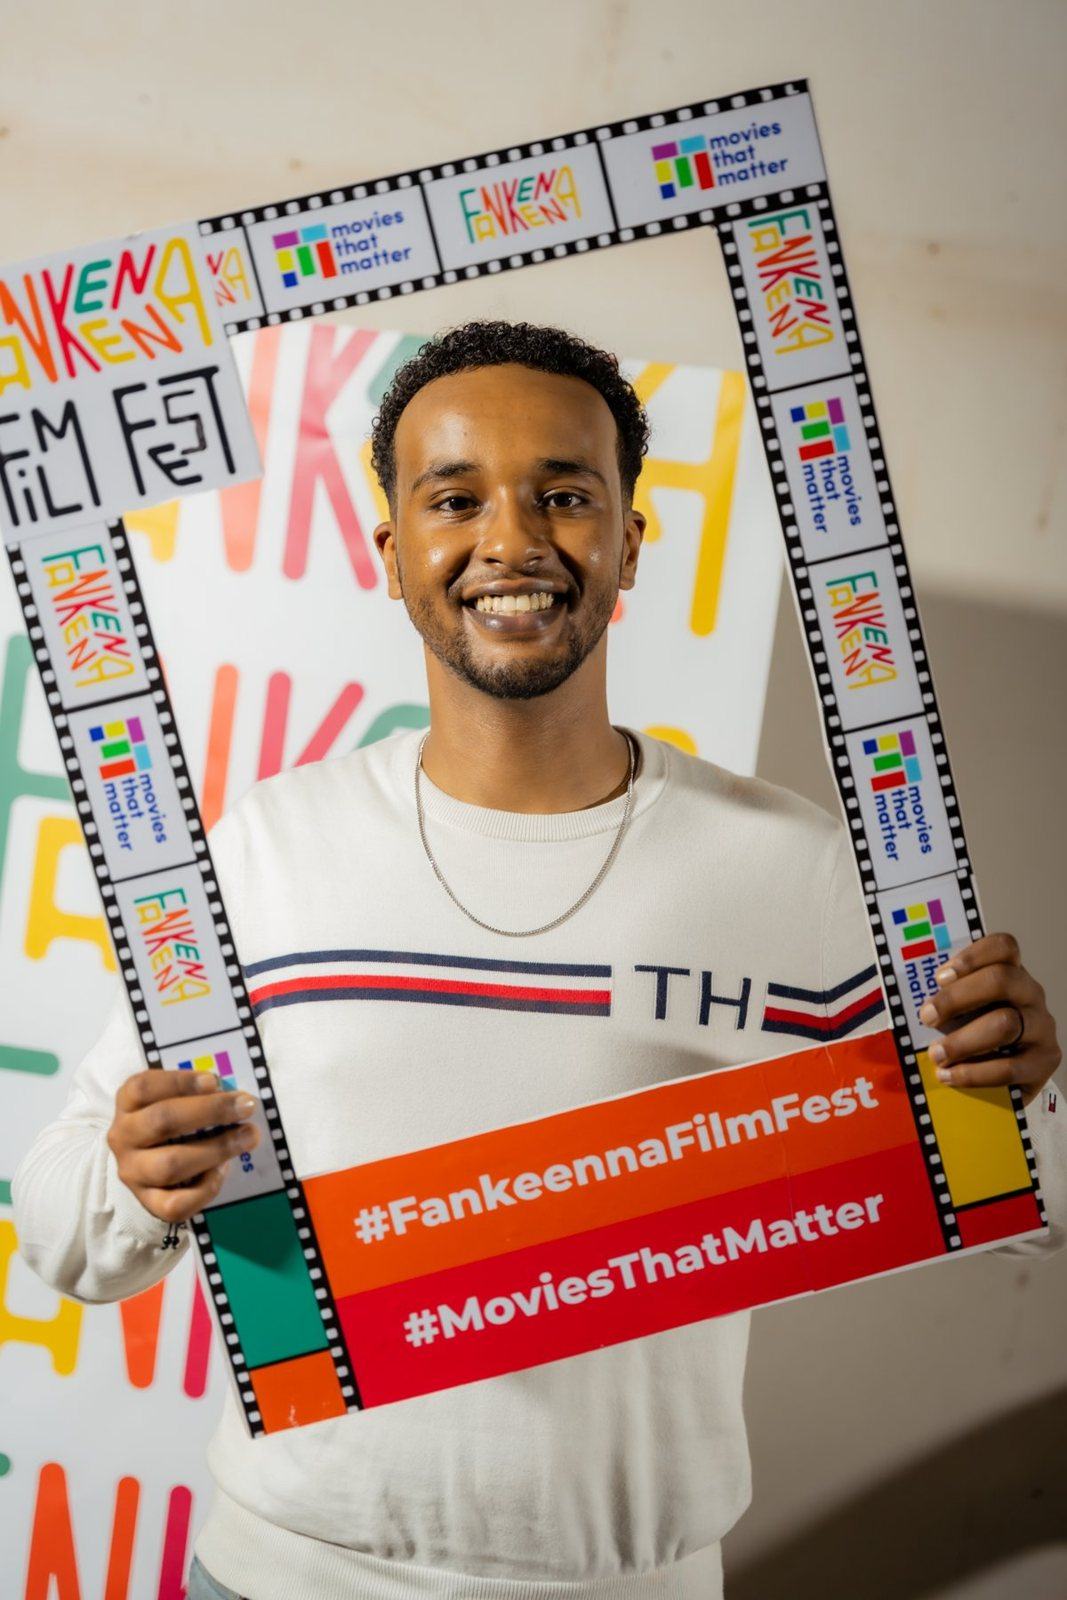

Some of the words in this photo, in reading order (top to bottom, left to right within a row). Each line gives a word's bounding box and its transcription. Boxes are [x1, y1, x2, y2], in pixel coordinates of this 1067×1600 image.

[709, 122, 782, 149] movies
[713, 145, 755, 168] that
[718, 159, 788, 186] matter
[331, 211, 404, 238] movies
[335, 233, 378, 256] that
[340, 247, 411, 274] matter
[802, 463, 828, 533] matter
[819, 459, 841, 500] that
[837, 455, 862, 526] movies
[103, 782, 132, 851] matter
[121, 777, 144, 818] that
[139, 774, 167, 844] movies
[891, 789, 913, 829] that
[908, 786, 932, 854] movies
[874, 793, 899, 861] matter
[634, 964, 752, 1031] TH
[353, 1076, 880, 1245] #FankeennaFilmFest
[403, 1193, 885, 1349] #MoviesThatMatter
